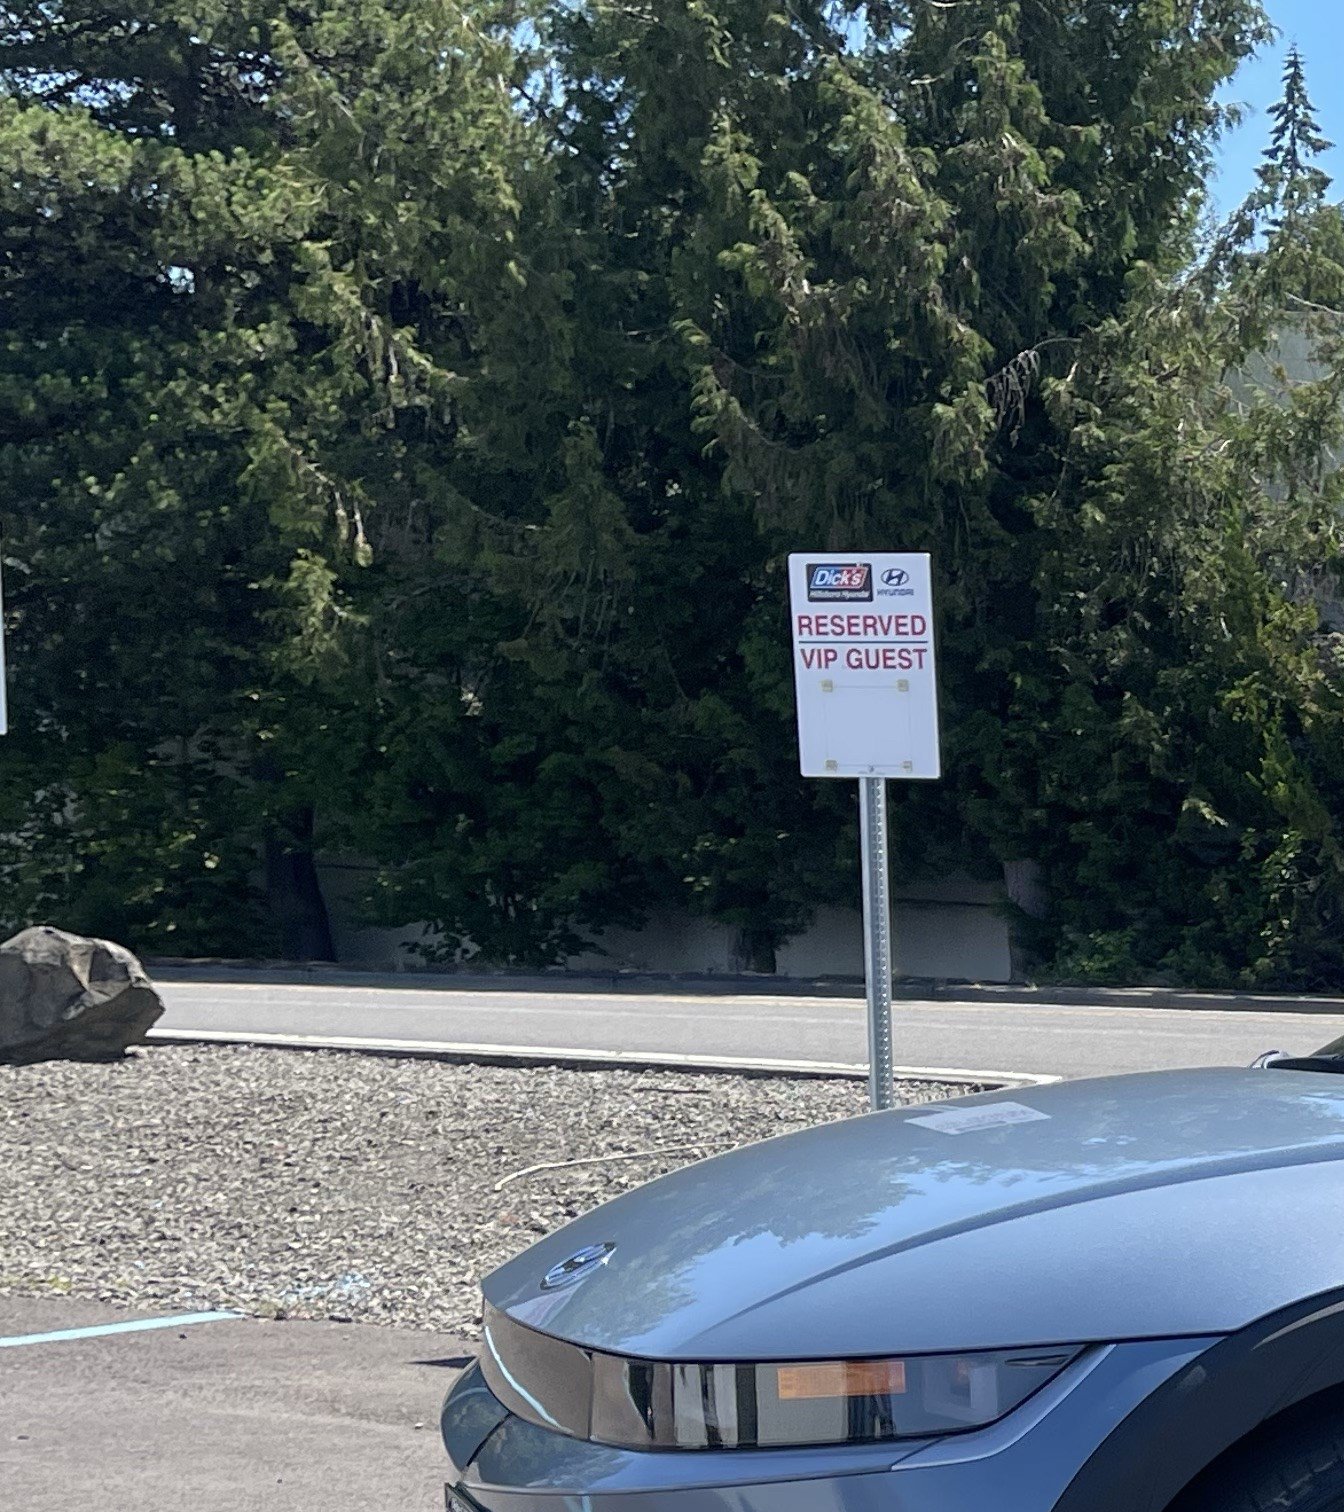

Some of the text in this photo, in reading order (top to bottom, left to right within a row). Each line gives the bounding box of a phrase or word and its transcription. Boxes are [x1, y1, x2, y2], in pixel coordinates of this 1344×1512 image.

[798, 615, 927, 636] RESERVED
[800, 648, 927, 669] VIP GUEST
